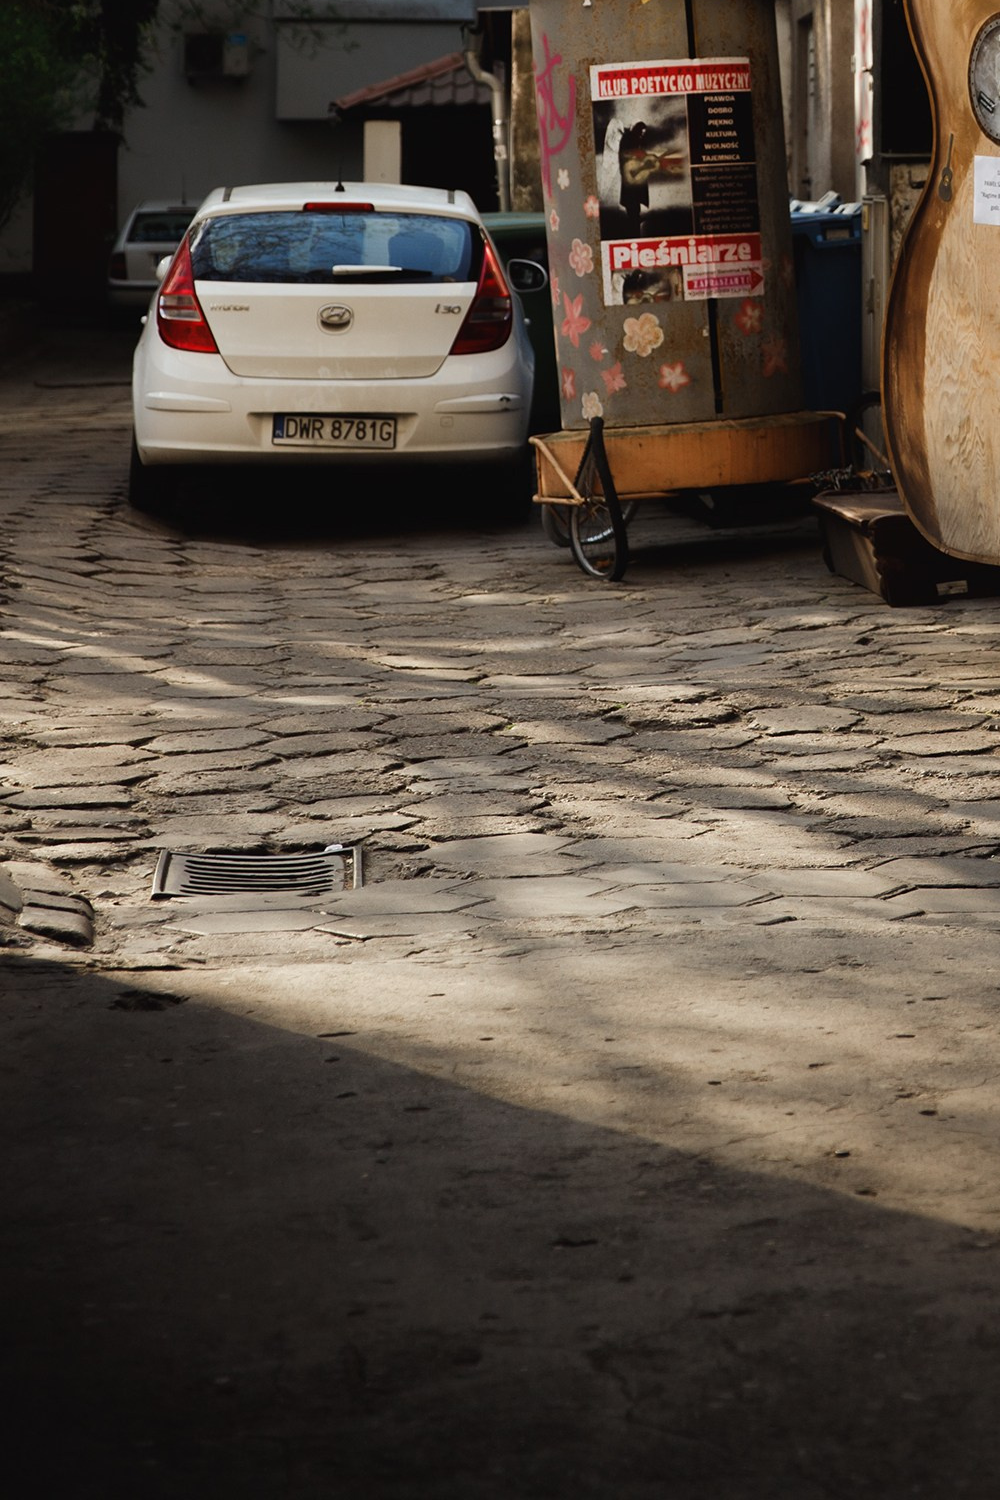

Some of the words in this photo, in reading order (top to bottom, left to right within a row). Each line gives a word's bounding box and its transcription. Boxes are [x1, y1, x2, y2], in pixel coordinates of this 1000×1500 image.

[600, 78, 628, 96] KLUB
[631, 74, 693, 97] POETYCKO
[695, 73, 749, 90] MUZYCZNY
[707, 106, 733, 114] DOBRO
[707, 118, 734, 127] PIĘKNO
[705, 130, 737, 138] KULTURA
[703, 141, 739, 150] WOLNOŚĆ
[613, 238, 751, 269] Pieśniarze
[434, 303, 461, 314] i30
[286, 417, 324, 439] DWR
[331, 419, 393, 441] 8781G
